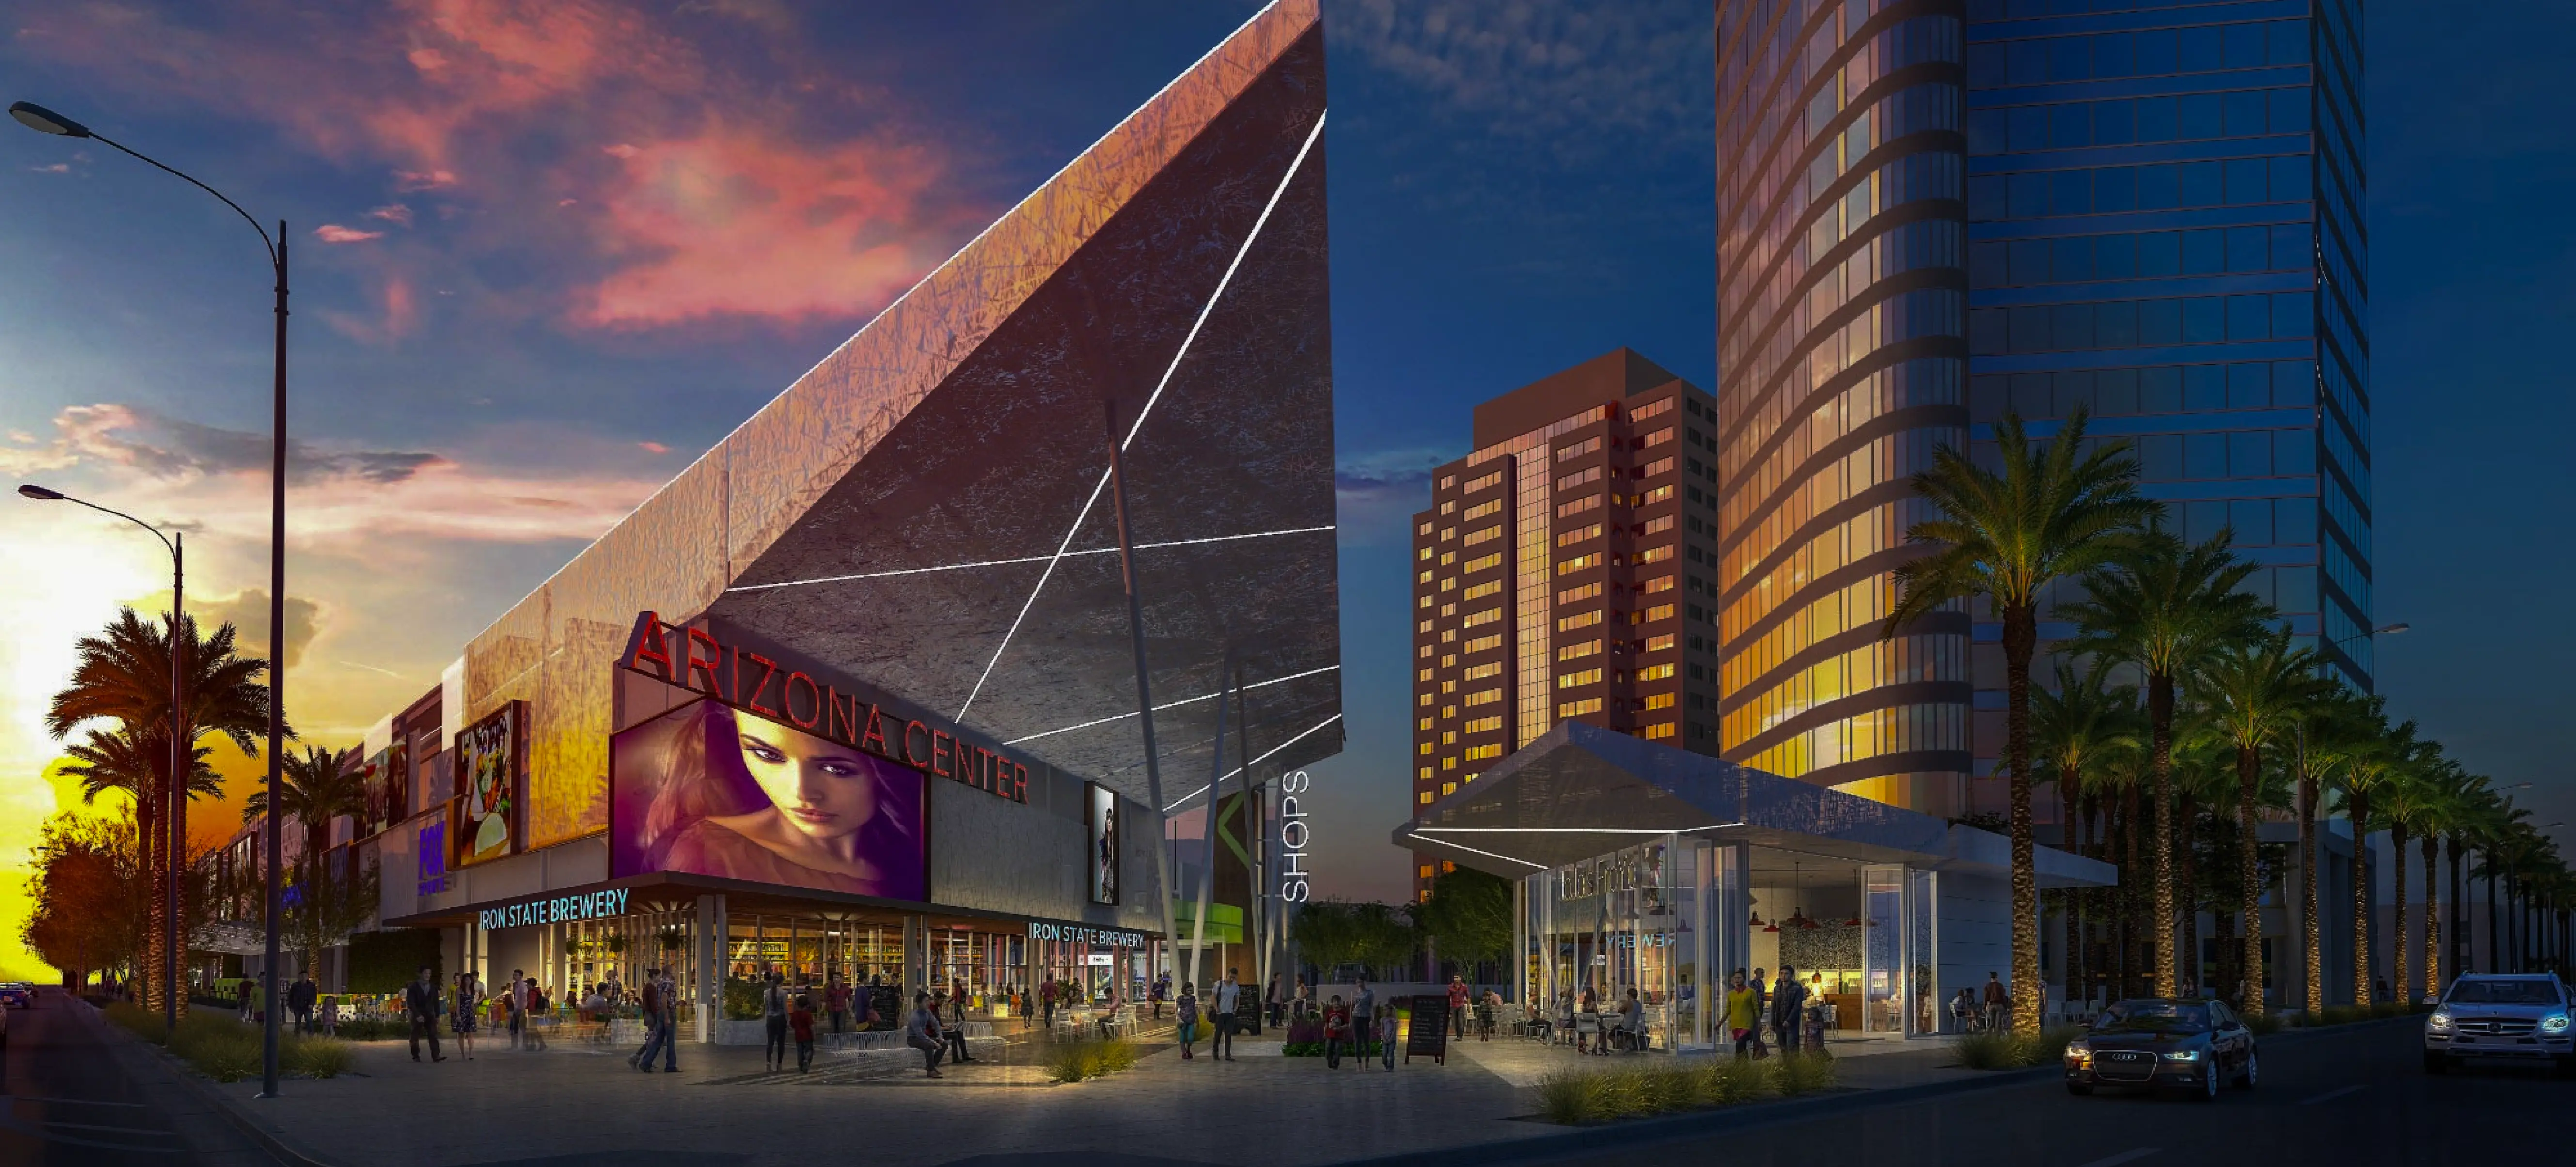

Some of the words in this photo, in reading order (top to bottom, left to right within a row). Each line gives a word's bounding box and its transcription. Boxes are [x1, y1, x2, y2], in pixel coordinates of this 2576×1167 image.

[630, 611, 887, 756] ARIZONA
[905, 720, 1029, 805] CENTER
[419, 821, 445, 880] FOX
[1283, 771, 1309, 902] SHOPS
[480, 907, 505, 930] IRON
[509, 901, 547, 927] STATE
[550, 887, 629, 922] BREWERY
[1029, 922, 1060, 941] IRON
[1063, 926, 1097, 944] STATE
[1100, 930, 1144, 948] BREWERY
